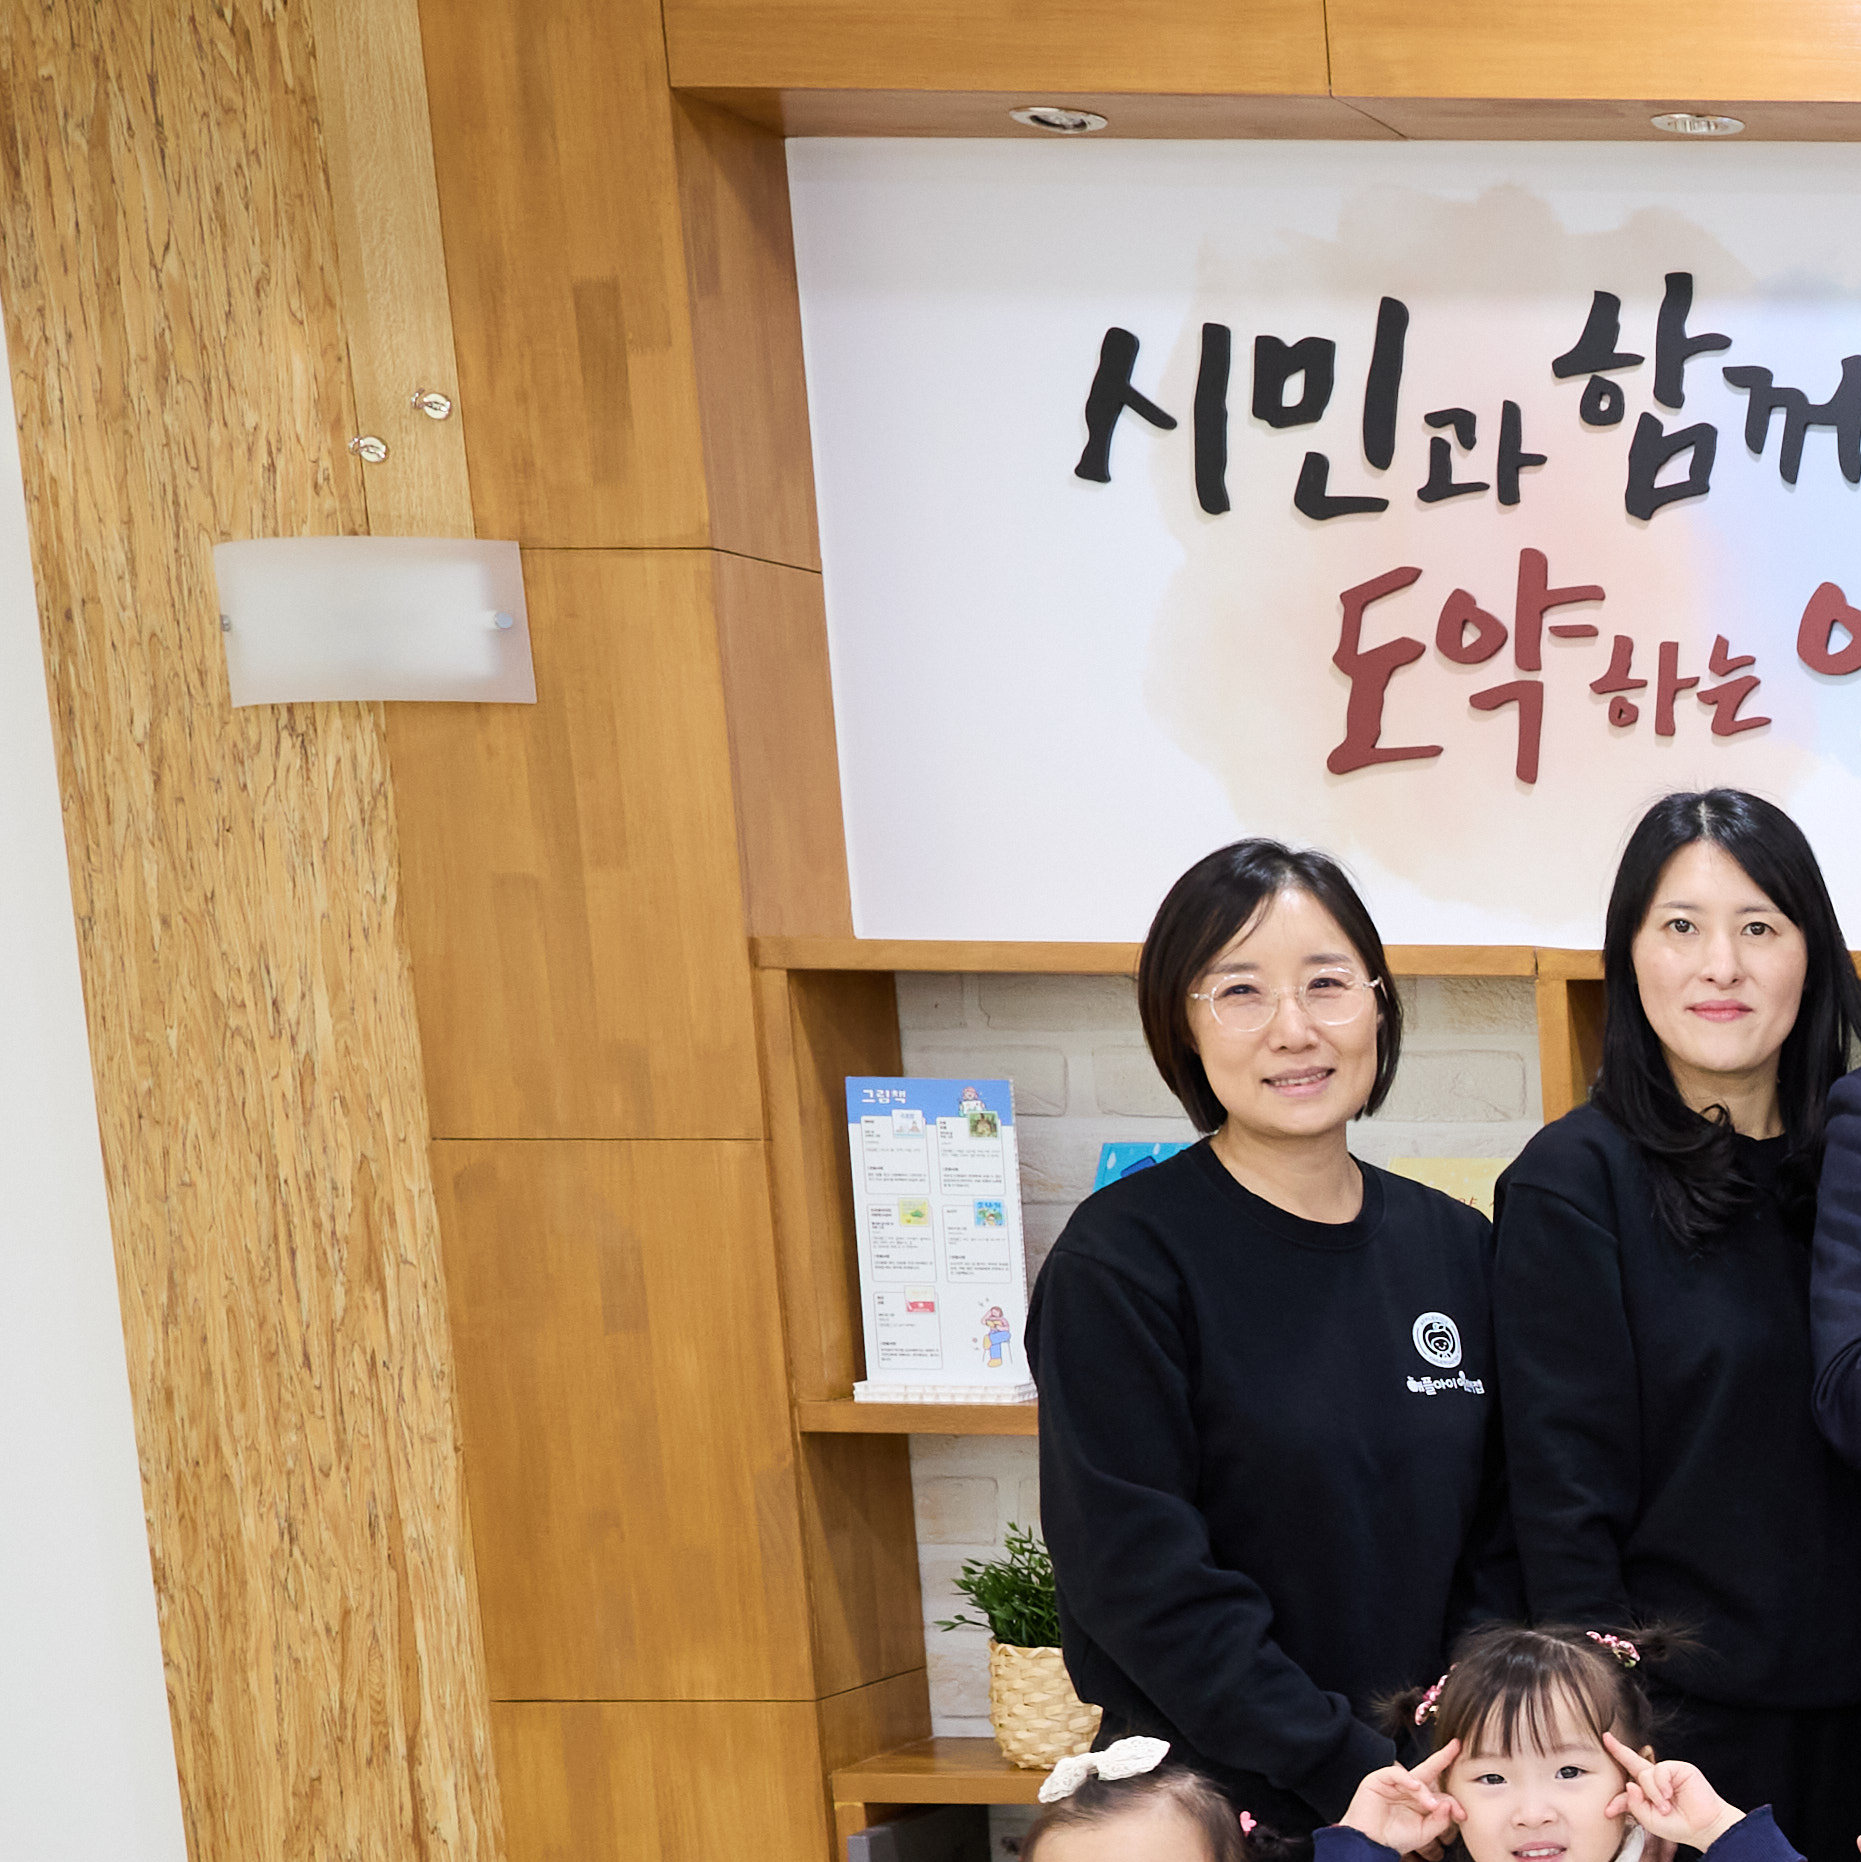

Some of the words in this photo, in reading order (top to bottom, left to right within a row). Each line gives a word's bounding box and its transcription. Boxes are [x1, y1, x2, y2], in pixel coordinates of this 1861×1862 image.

[1074, 296, 1547, 521] 시민과
[1326, 547, 1771, 784] 도약하는
[861, 1088, 907, 1105] 그림책
